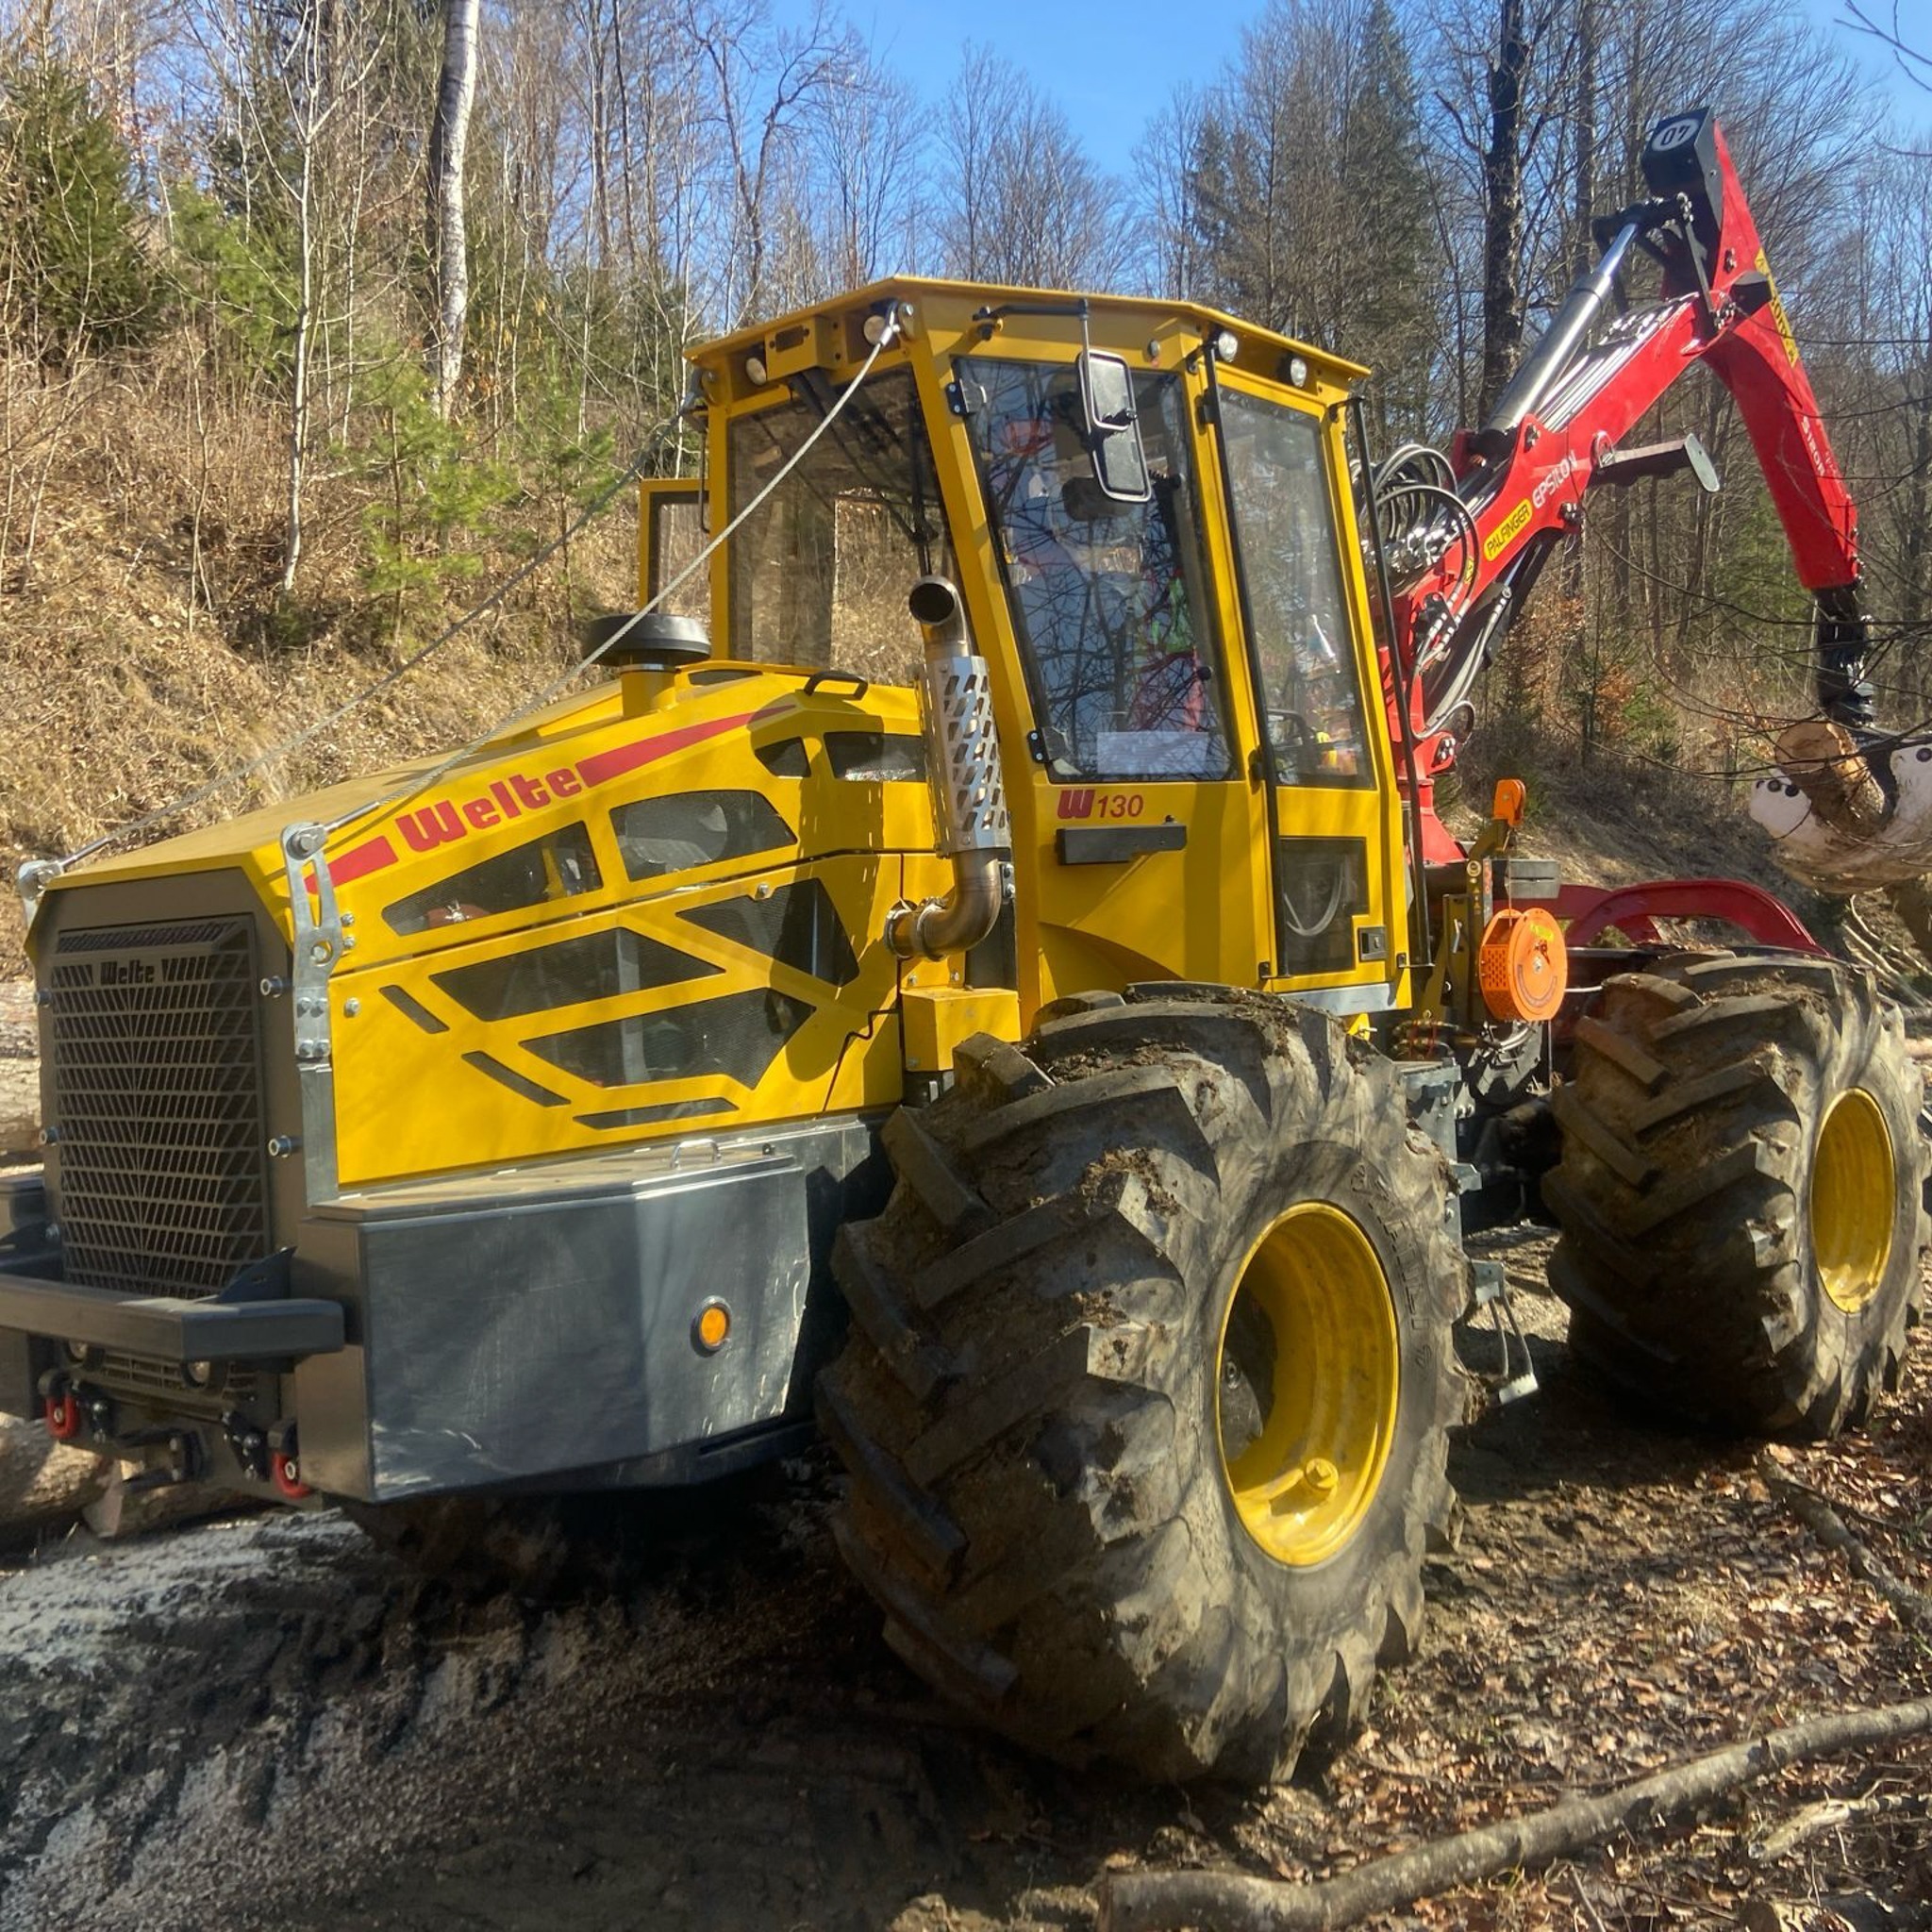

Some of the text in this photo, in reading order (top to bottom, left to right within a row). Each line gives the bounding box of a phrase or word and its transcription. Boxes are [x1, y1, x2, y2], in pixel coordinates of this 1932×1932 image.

[1486, 449, 1578, 557] PALFINGER EPSILON
[394, 768, 583, 852] Welte
[1097, 794, 1144, 819] 130
[100, 959, 155, 986] Welte
